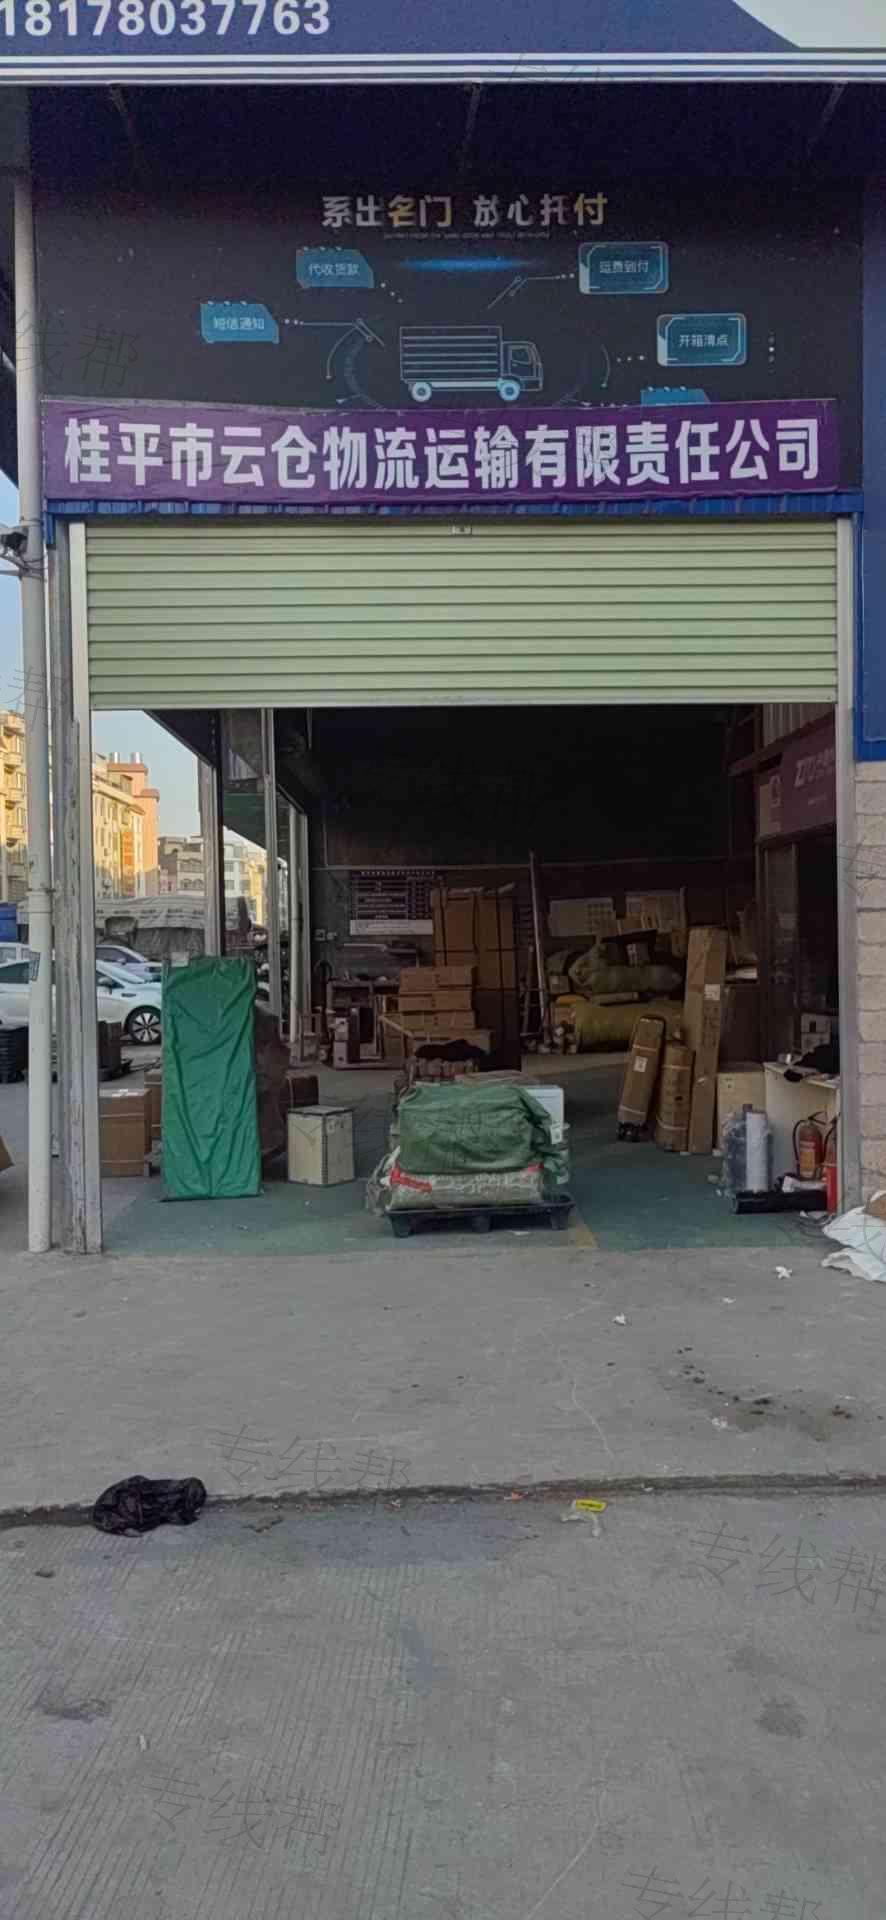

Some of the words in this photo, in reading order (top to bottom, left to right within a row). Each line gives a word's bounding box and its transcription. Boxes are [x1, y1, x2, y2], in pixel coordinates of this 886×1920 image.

[0, 0, 330, 36] 18178037763
[321, 196, 453, 228] 系出名门
[473, 192, 608, 227] 放心托付
[64, 417, 820, 491] 桂平市云仓物流运输有限责任公司
